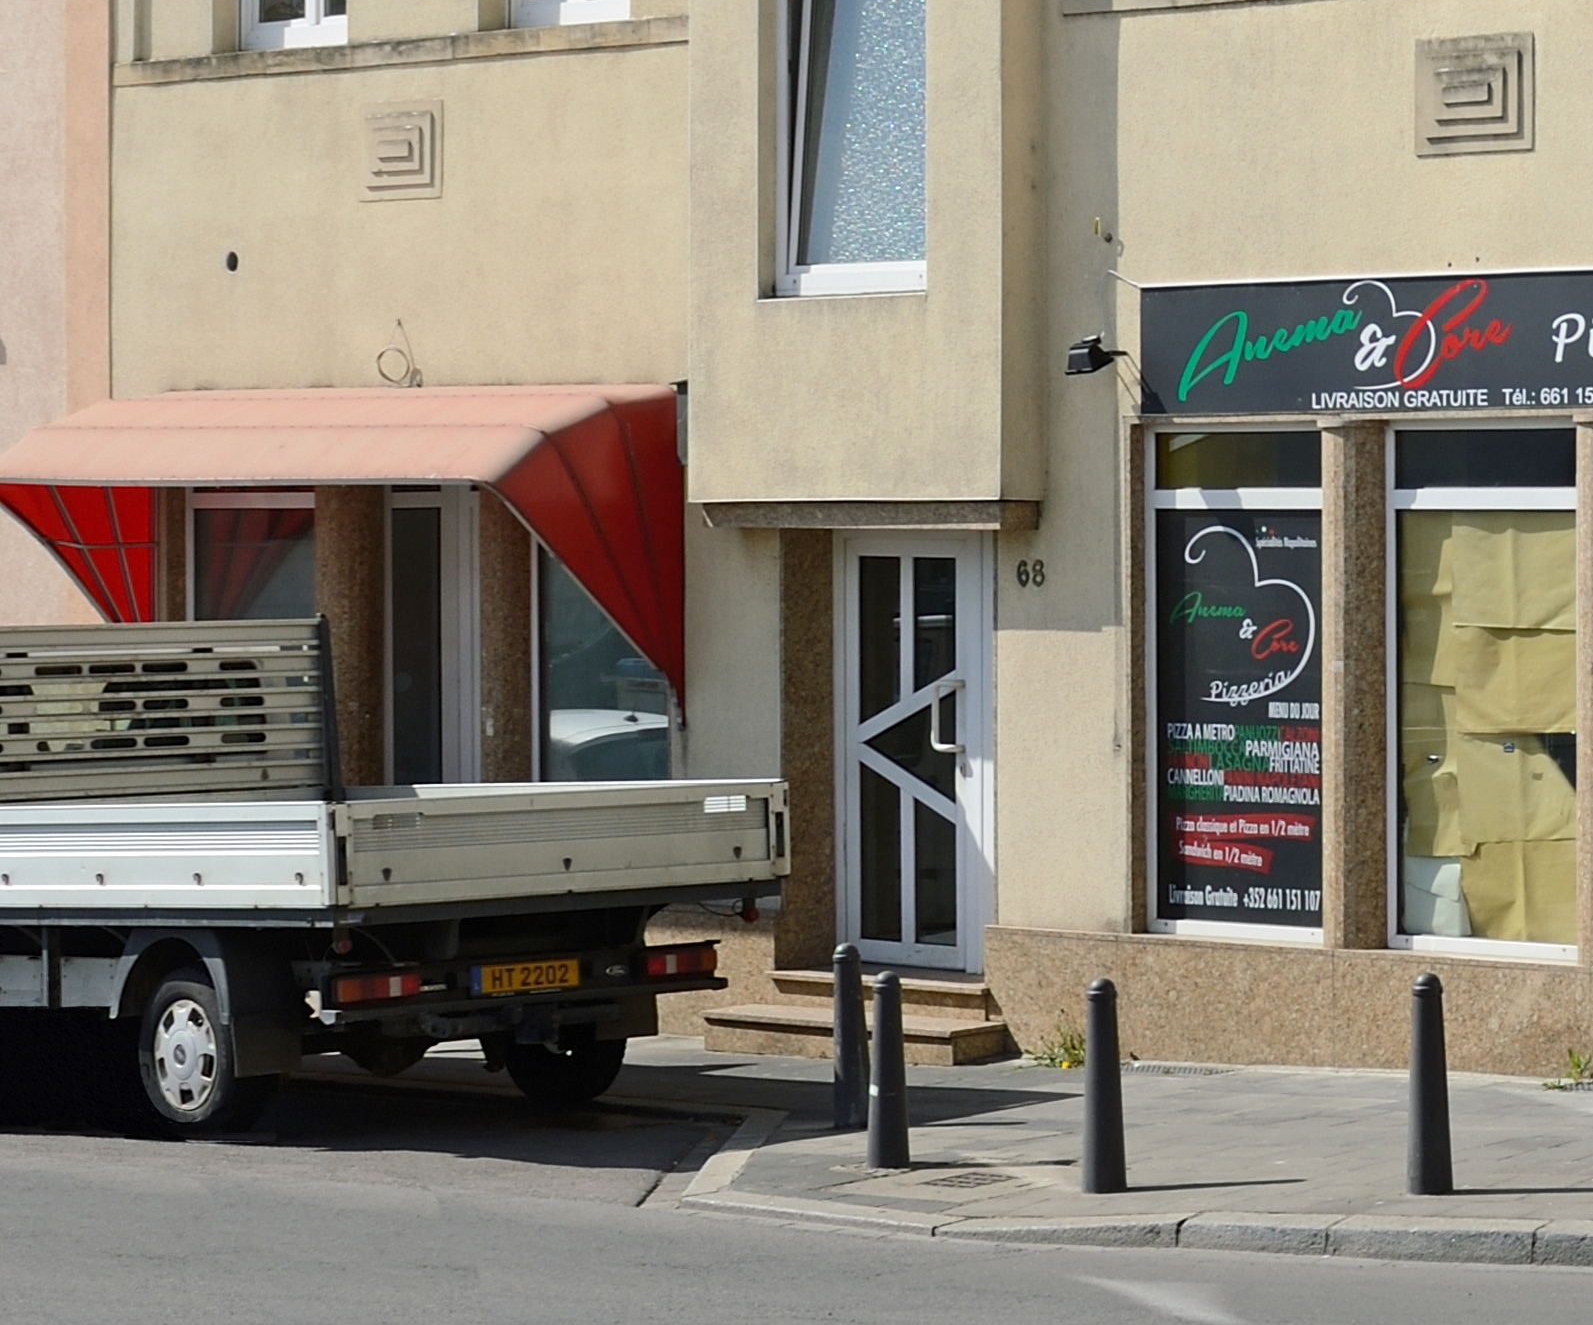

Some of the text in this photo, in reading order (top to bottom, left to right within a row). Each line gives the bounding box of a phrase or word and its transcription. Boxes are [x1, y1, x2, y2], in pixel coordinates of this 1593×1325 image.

[1177, 278, 1514, 402] Anema & Core
[1311, 391, 1399, 410] LIVRAISON
[1403, 388, 1488, 407] GRATUITE
[1539, 387, 1569, 405] 661
[1016, 559, 1045, 588] 68
[1169, 591, 1246, 624] Anema
[1239, 618, 1299, 660] & Core
[1209, 669, 1292, 707] Pizzeria
[1268, 702, 1288, 718] MENU
[1301, 703, 1320, 720] JOUR
[1167, 723, 1192, 739] PIZZA
[1202, 724, 1235, 740] METRO
[1246, 740, 1320, 757] PARMIGIANA
[1270, 757, 1320, 774] FRITTATINE
[1167, 768, 1224, 785] CANNELLONI
[1224, 785, 1260, 802] PIADINA
[1262, 787, 1320, 804] ROMAGNOLA
[1271, 820, 1286, 836] 1/2
[1225, 847, 1239, 863] 1/2
[1169, 883, 1321, 911] Livraison Gratuite +352 661 151 107
[491, 968, 515, 989] HT
[520, 963, 568, 986] 2202
